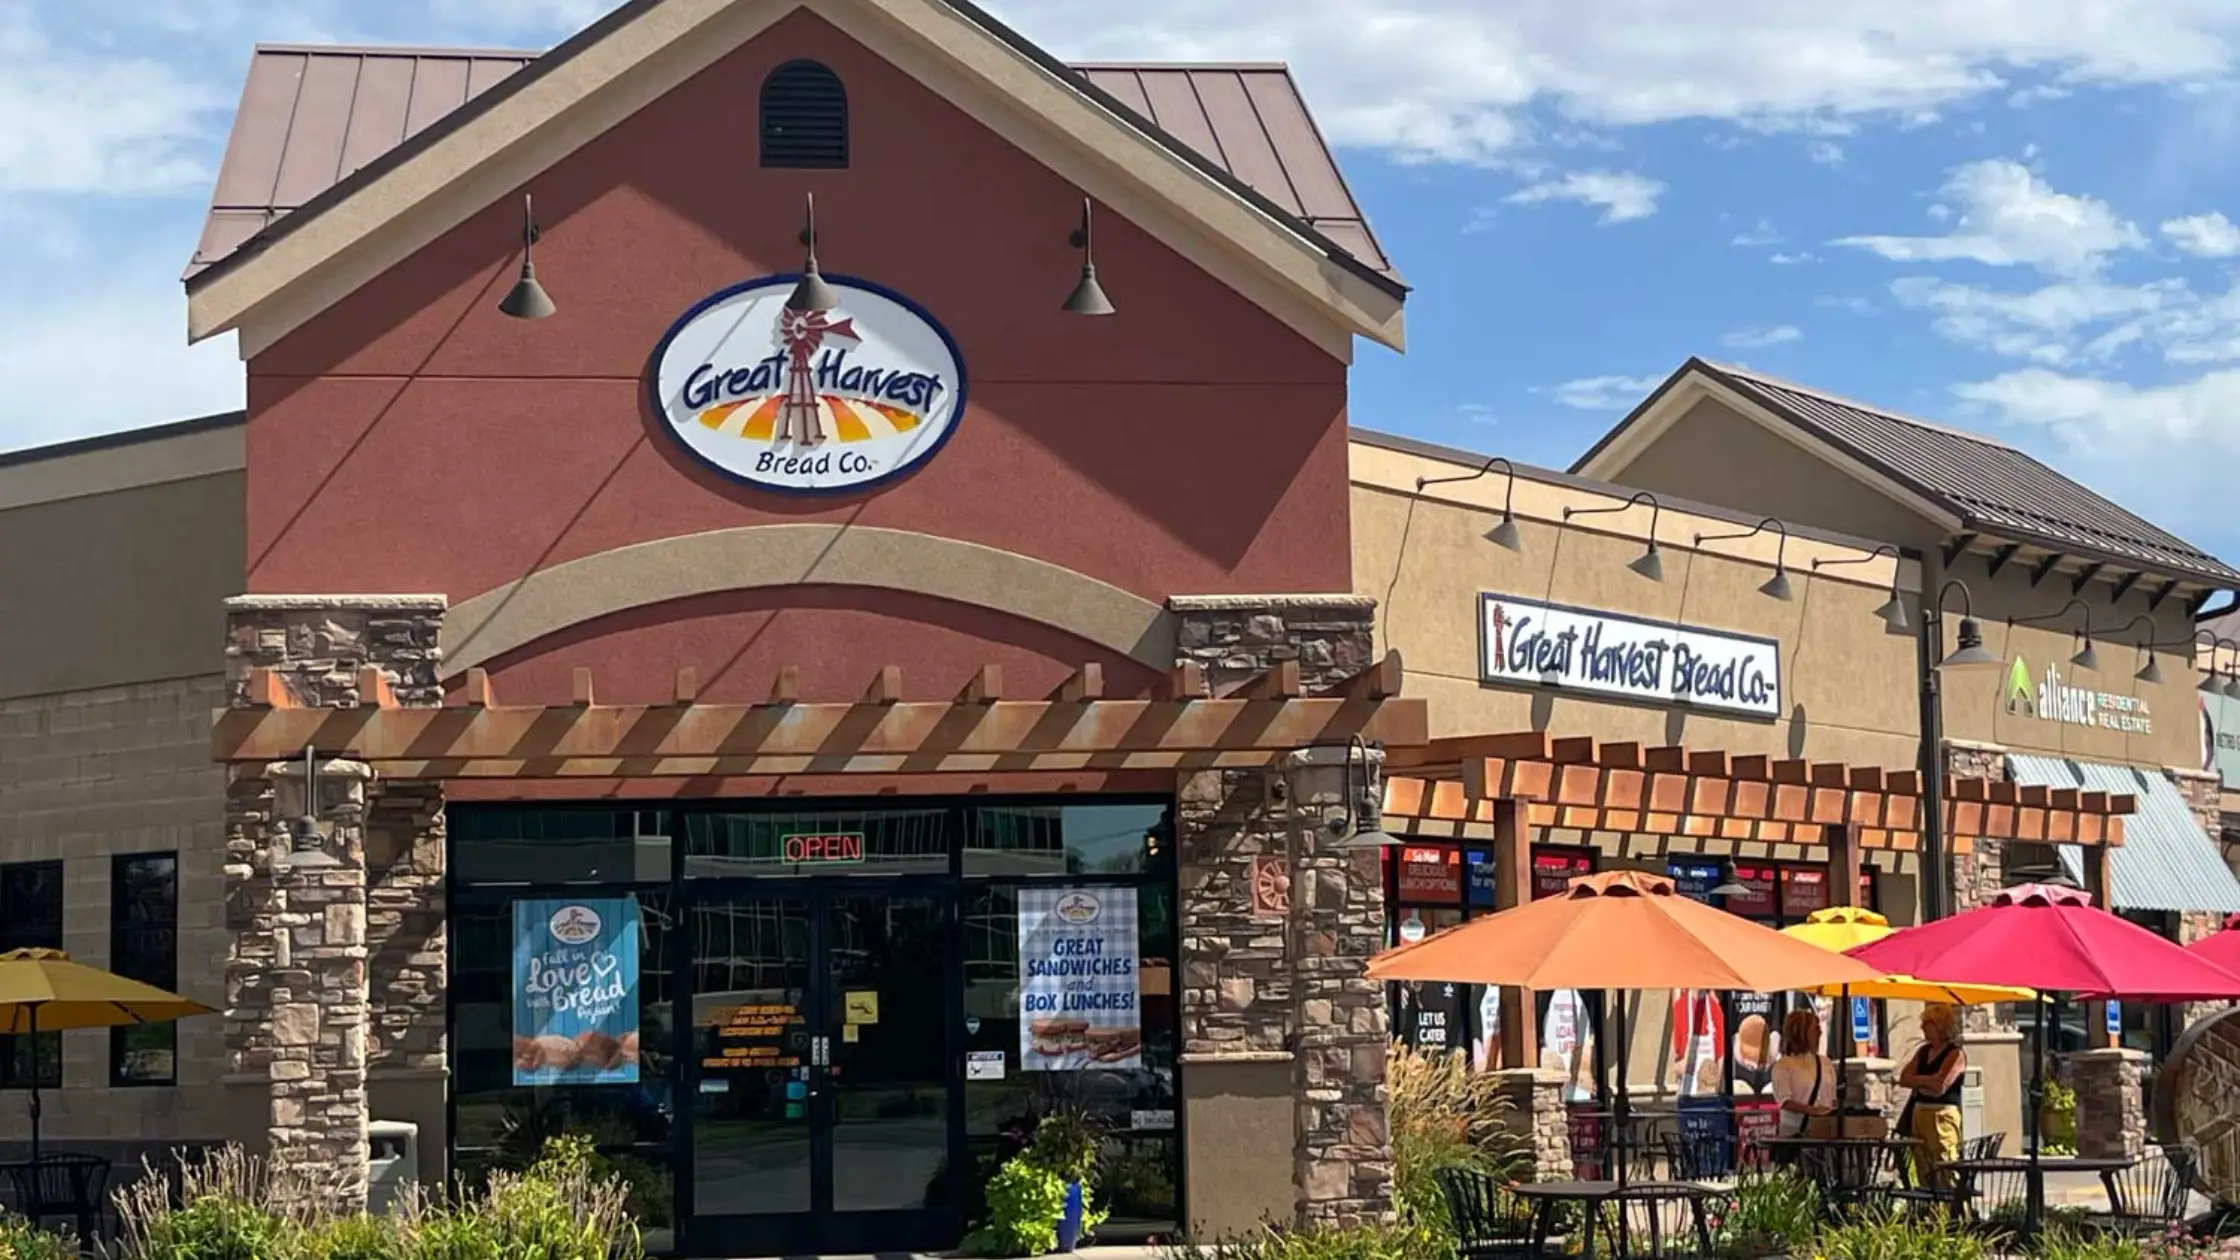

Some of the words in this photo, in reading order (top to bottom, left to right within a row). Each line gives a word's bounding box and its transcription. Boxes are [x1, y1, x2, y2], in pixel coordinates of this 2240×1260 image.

[683, 349, 788, 409] Great
[818, 349, 943, 412] Harvest
[755, 452, 829, 474] Bread
[1508, 616, 1578, 677] Great
[1581, 621, 1670, 690] Harvest
[1671, 643, 1734, 699] Bread
[2039, 662, 2095, 726] alliance
[2097, 692, 2150, 715] RESIDENTIAL
[2098, 712, 2120, 729] REAL
[2121, 715, 2152, 734] ESTATE
[786, 836, 860, 860] OPEN
[543, 949, 568, 965] Fall
[1053, 938, 1104, 955] GREAT
[525, 957, 592, 993] Love
[1027, 958, 1131, 977] SANDWICHES
[552, 971, 626, 1011] Bread
[1067, 978, 1094, 991] and
[1063, 991, 1134, 1011] LUNCHES!
[1418, 1012, 1432, 1026] LET
[1434, 1012, 1446, 1026] US
[1420, 1028, 1446, 1042] CATER
